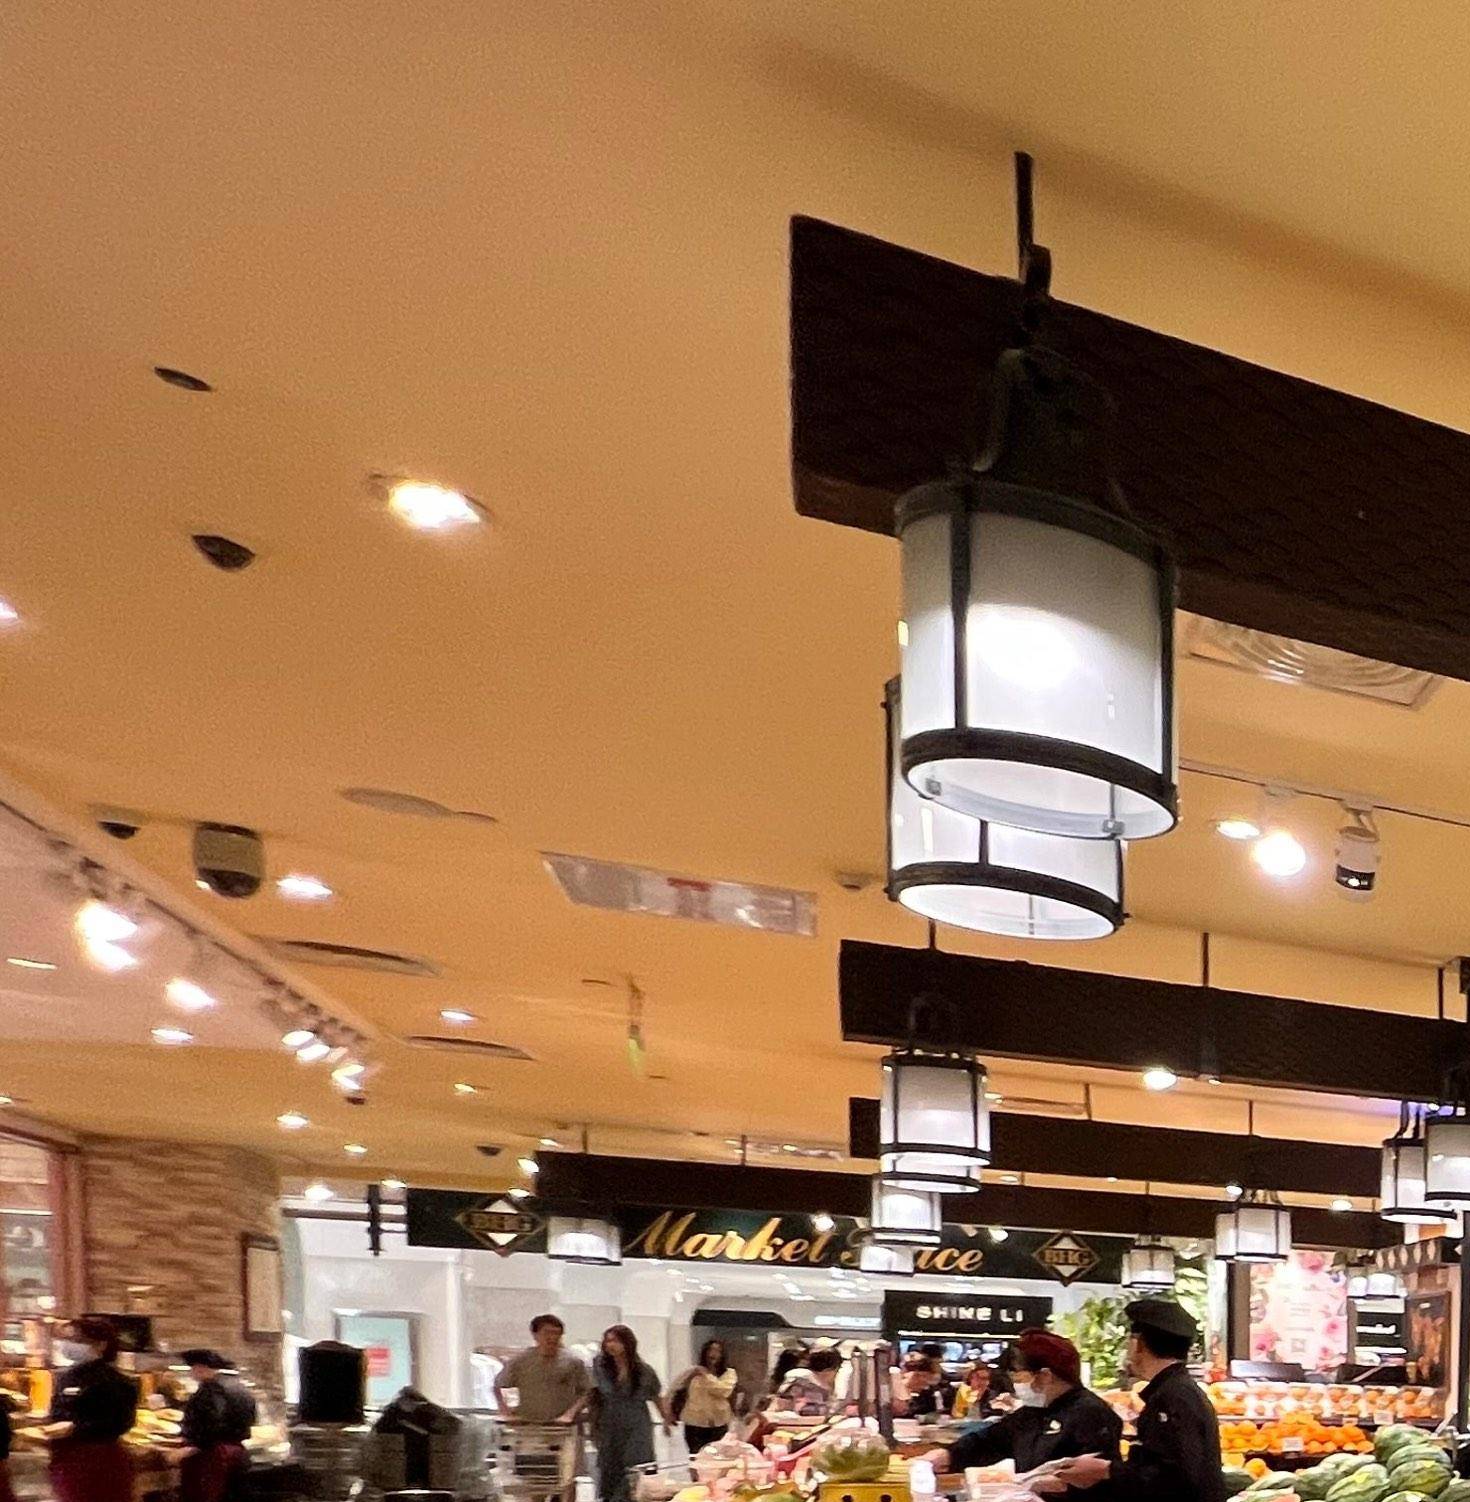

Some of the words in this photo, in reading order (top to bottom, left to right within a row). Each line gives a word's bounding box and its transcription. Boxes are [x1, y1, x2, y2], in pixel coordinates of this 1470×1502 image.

[623, 1210, 837, 1262] Market
[1043, 1250, 1090, 1266] BHG
[915, 1305, 992, 1321] SHINE
[1001, 1308, 1024, 1322] LI
